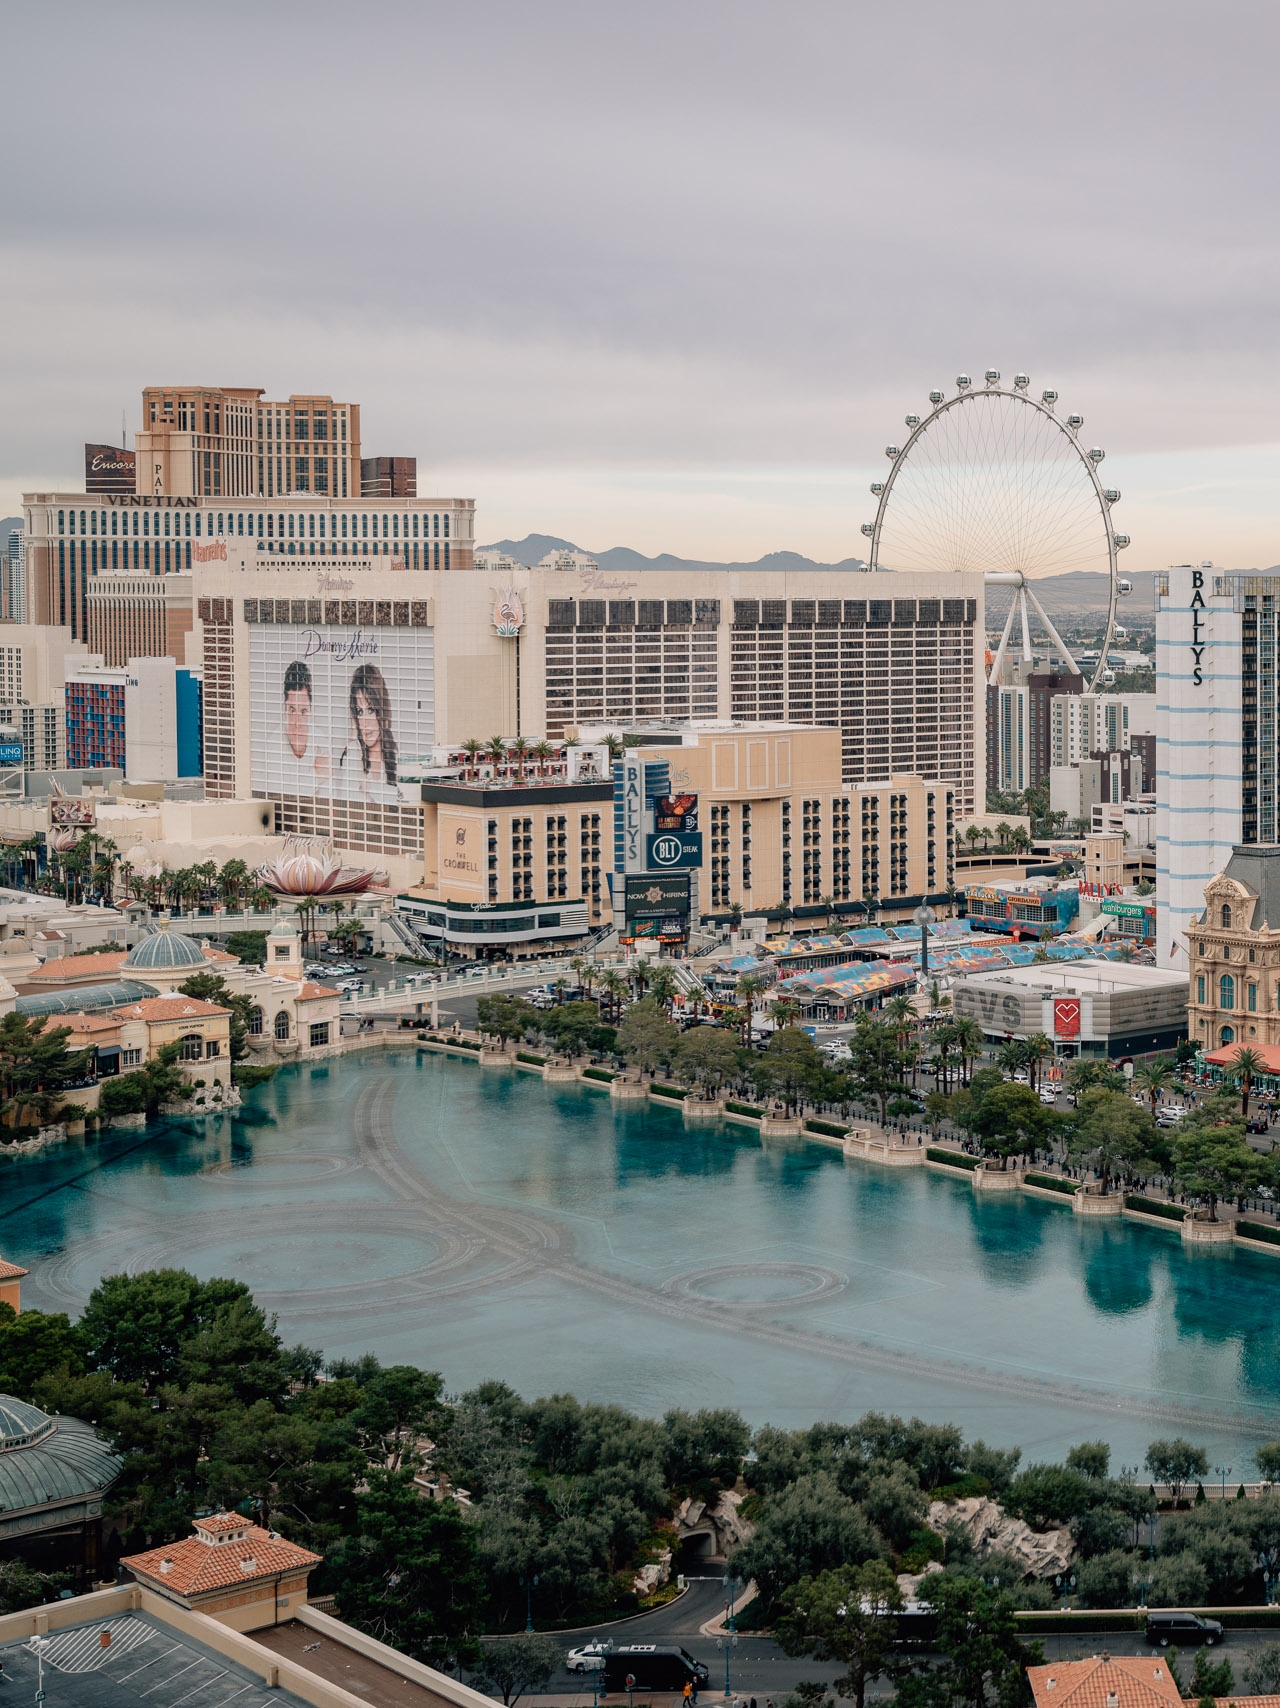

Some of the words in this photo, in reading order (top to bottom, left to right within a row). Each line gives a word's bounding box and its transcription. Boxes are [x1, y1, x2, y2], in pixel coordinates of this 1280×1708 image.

[91, 454, 136, 471] Encore
[107, 495, 199, 508] VENETIAN
[1189, 570, 1206, 687] BALLYS
[0, 747, 21, 755] LINQ
[659, 842, 676, 859] BLT
[443, 858, 479, 873] CROMWELL
[662, 891, 689, 899] HIRING
[964, 890, 995, 899] STARBUCKS
[1078, 879, 1123, 898] BALLY'S
[1007, 896, 1040, 905] GIORDANO'S
[1101, 903, 1142, 916] wahlburgers
[955, 987, 1021, 1029] CVS
